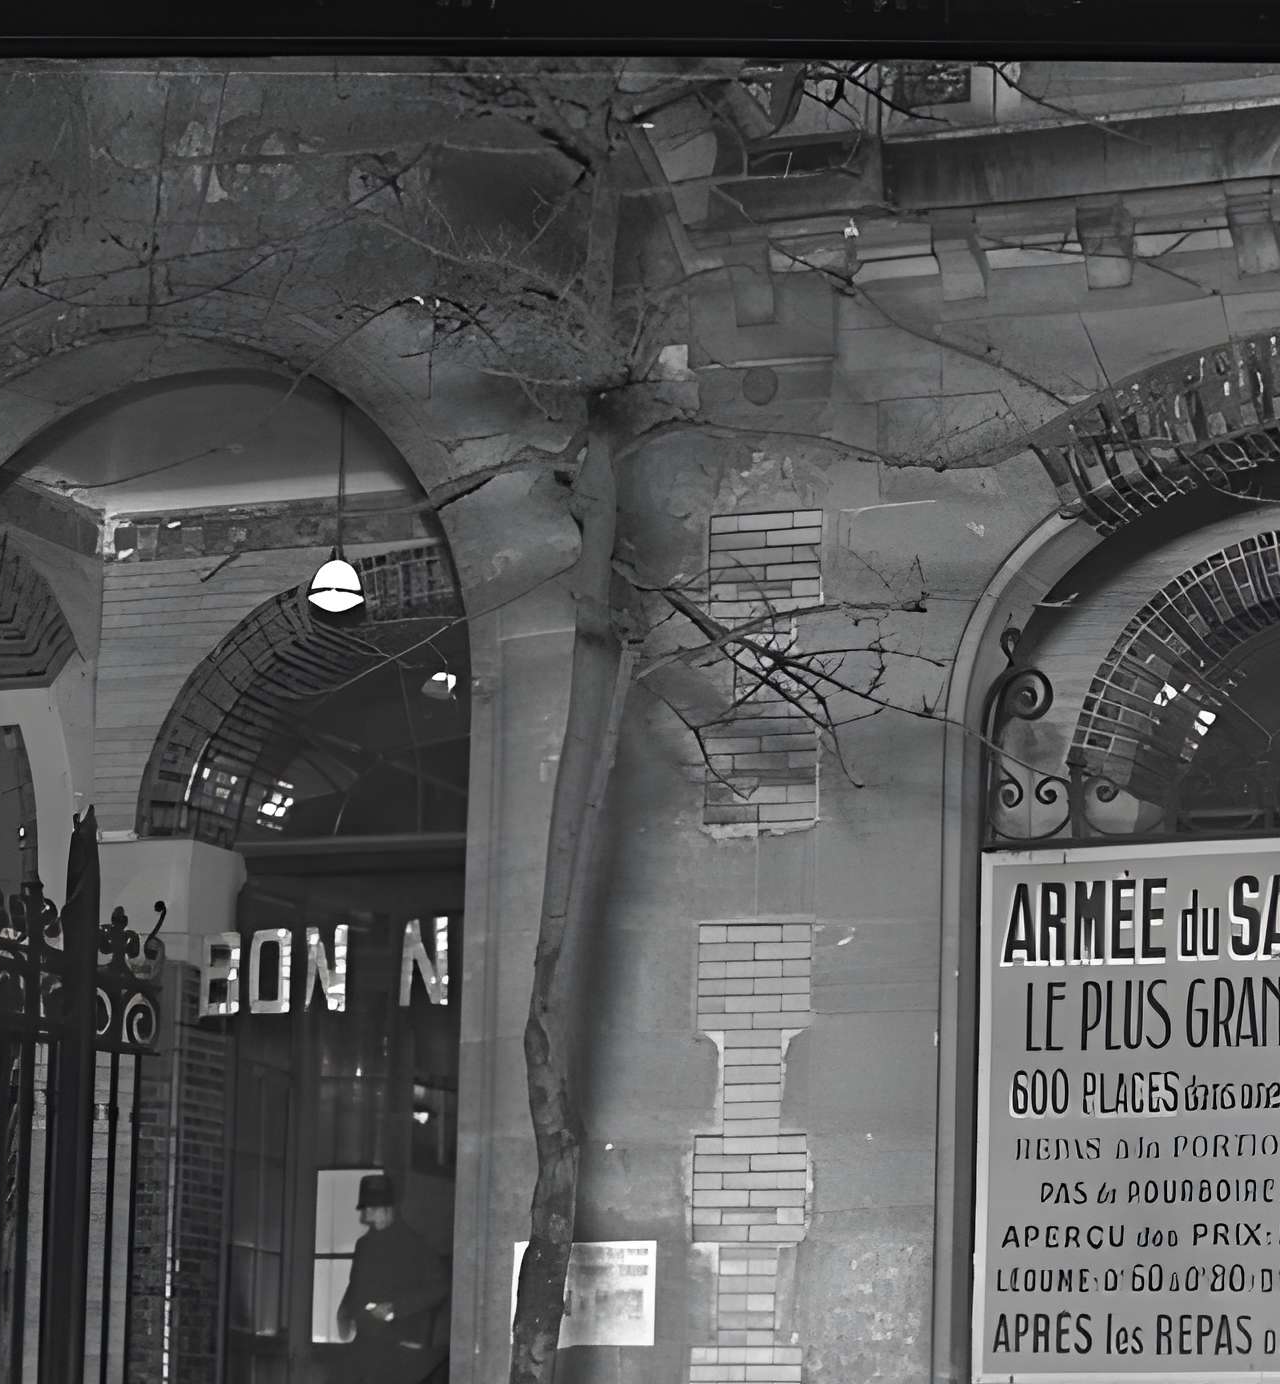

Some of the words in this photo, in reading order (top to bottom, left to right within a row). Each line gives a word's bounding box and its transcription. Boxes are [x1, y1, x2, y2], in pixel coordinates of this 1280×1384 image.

[1177, 888, 1220, 961] du
[198, 924, 349, 1017] BON
[1025, 982, 1066, 1051] LE
[1081, 978, 1171, 1051] PLUS
[1010, 1068, 1070, 1118] 600
[1082, 1071, 1179, 1118] PLACES
[1106, 1313, 1144, 1355] les
[1155, 1313, 1253, 1356] REPAS
